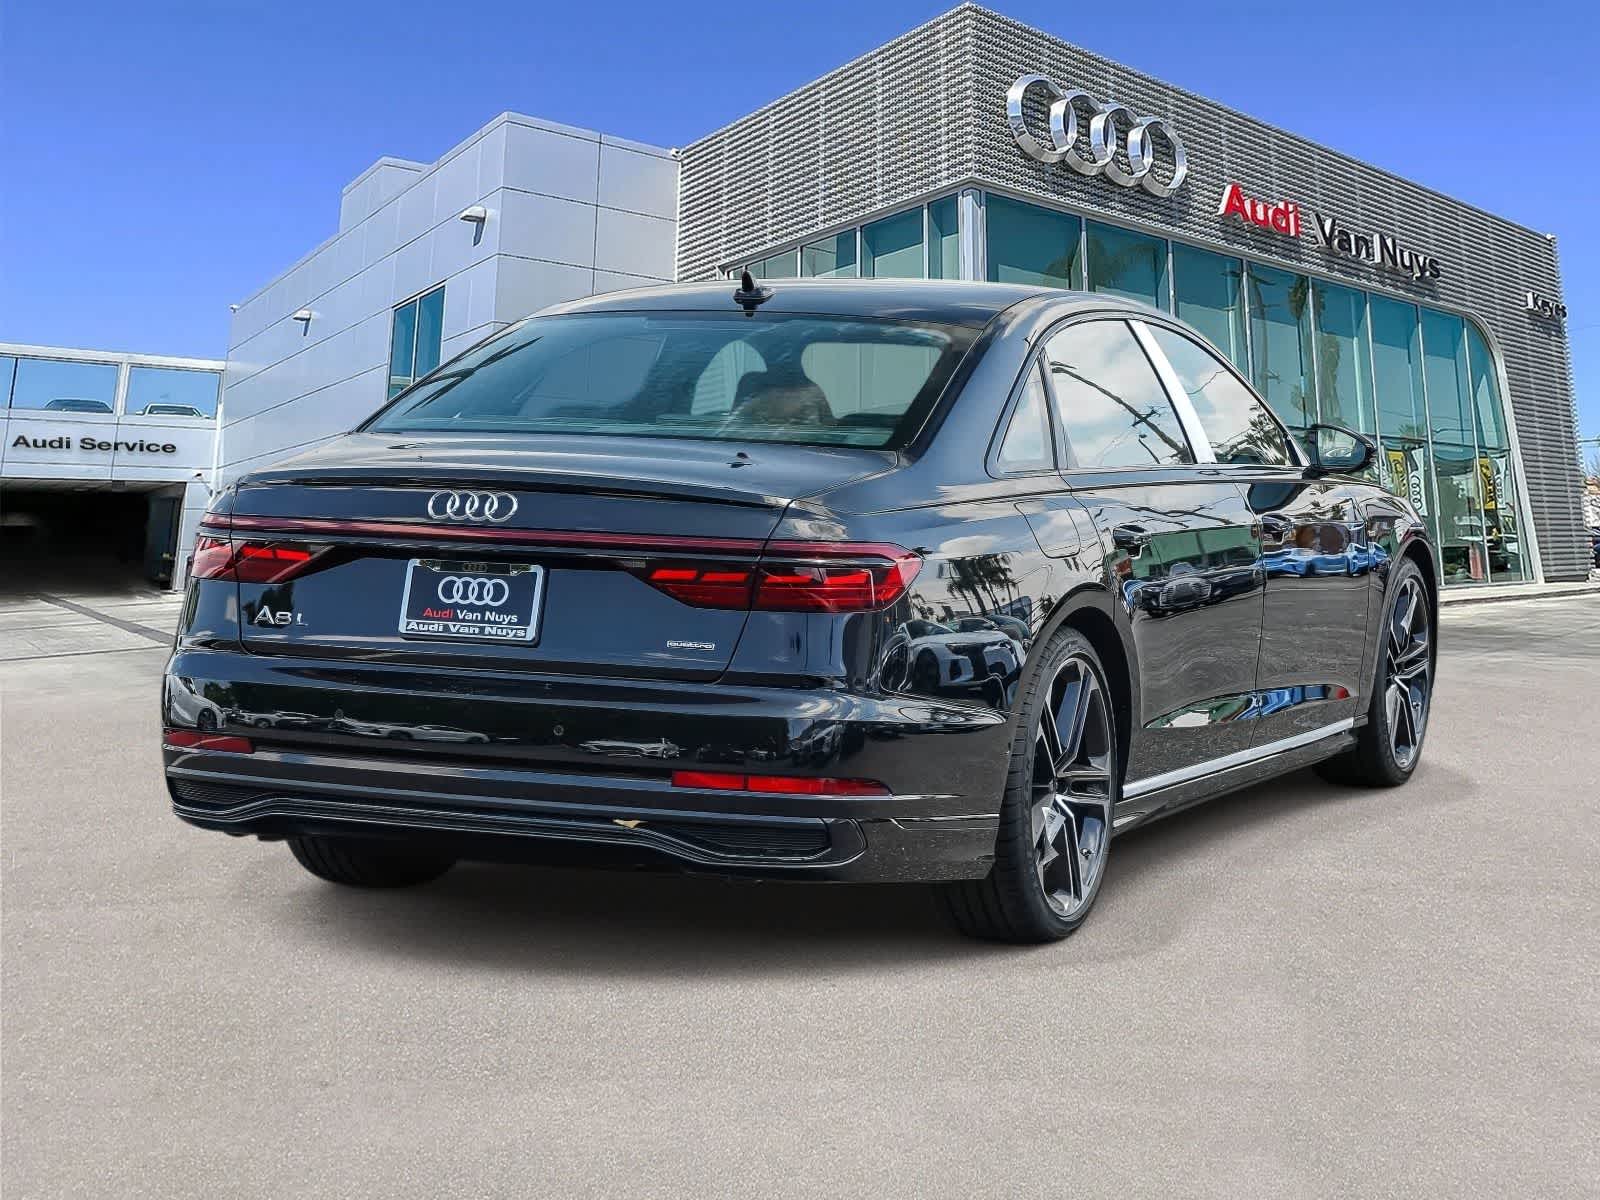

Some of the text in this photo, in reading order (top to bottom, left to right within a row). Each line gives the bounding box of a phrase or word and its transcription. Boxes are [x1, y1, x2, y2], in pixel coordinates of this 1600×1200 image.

[1218, 183, 1441, 280] Audi Van Nuys
[12, 435, 177, 453] Audi Service
[254, 605, 292, 624] A8
[423, 607, 518, 624] Audi Van Nuys
[406, 621, 526, 638] Audi Van Nuys
